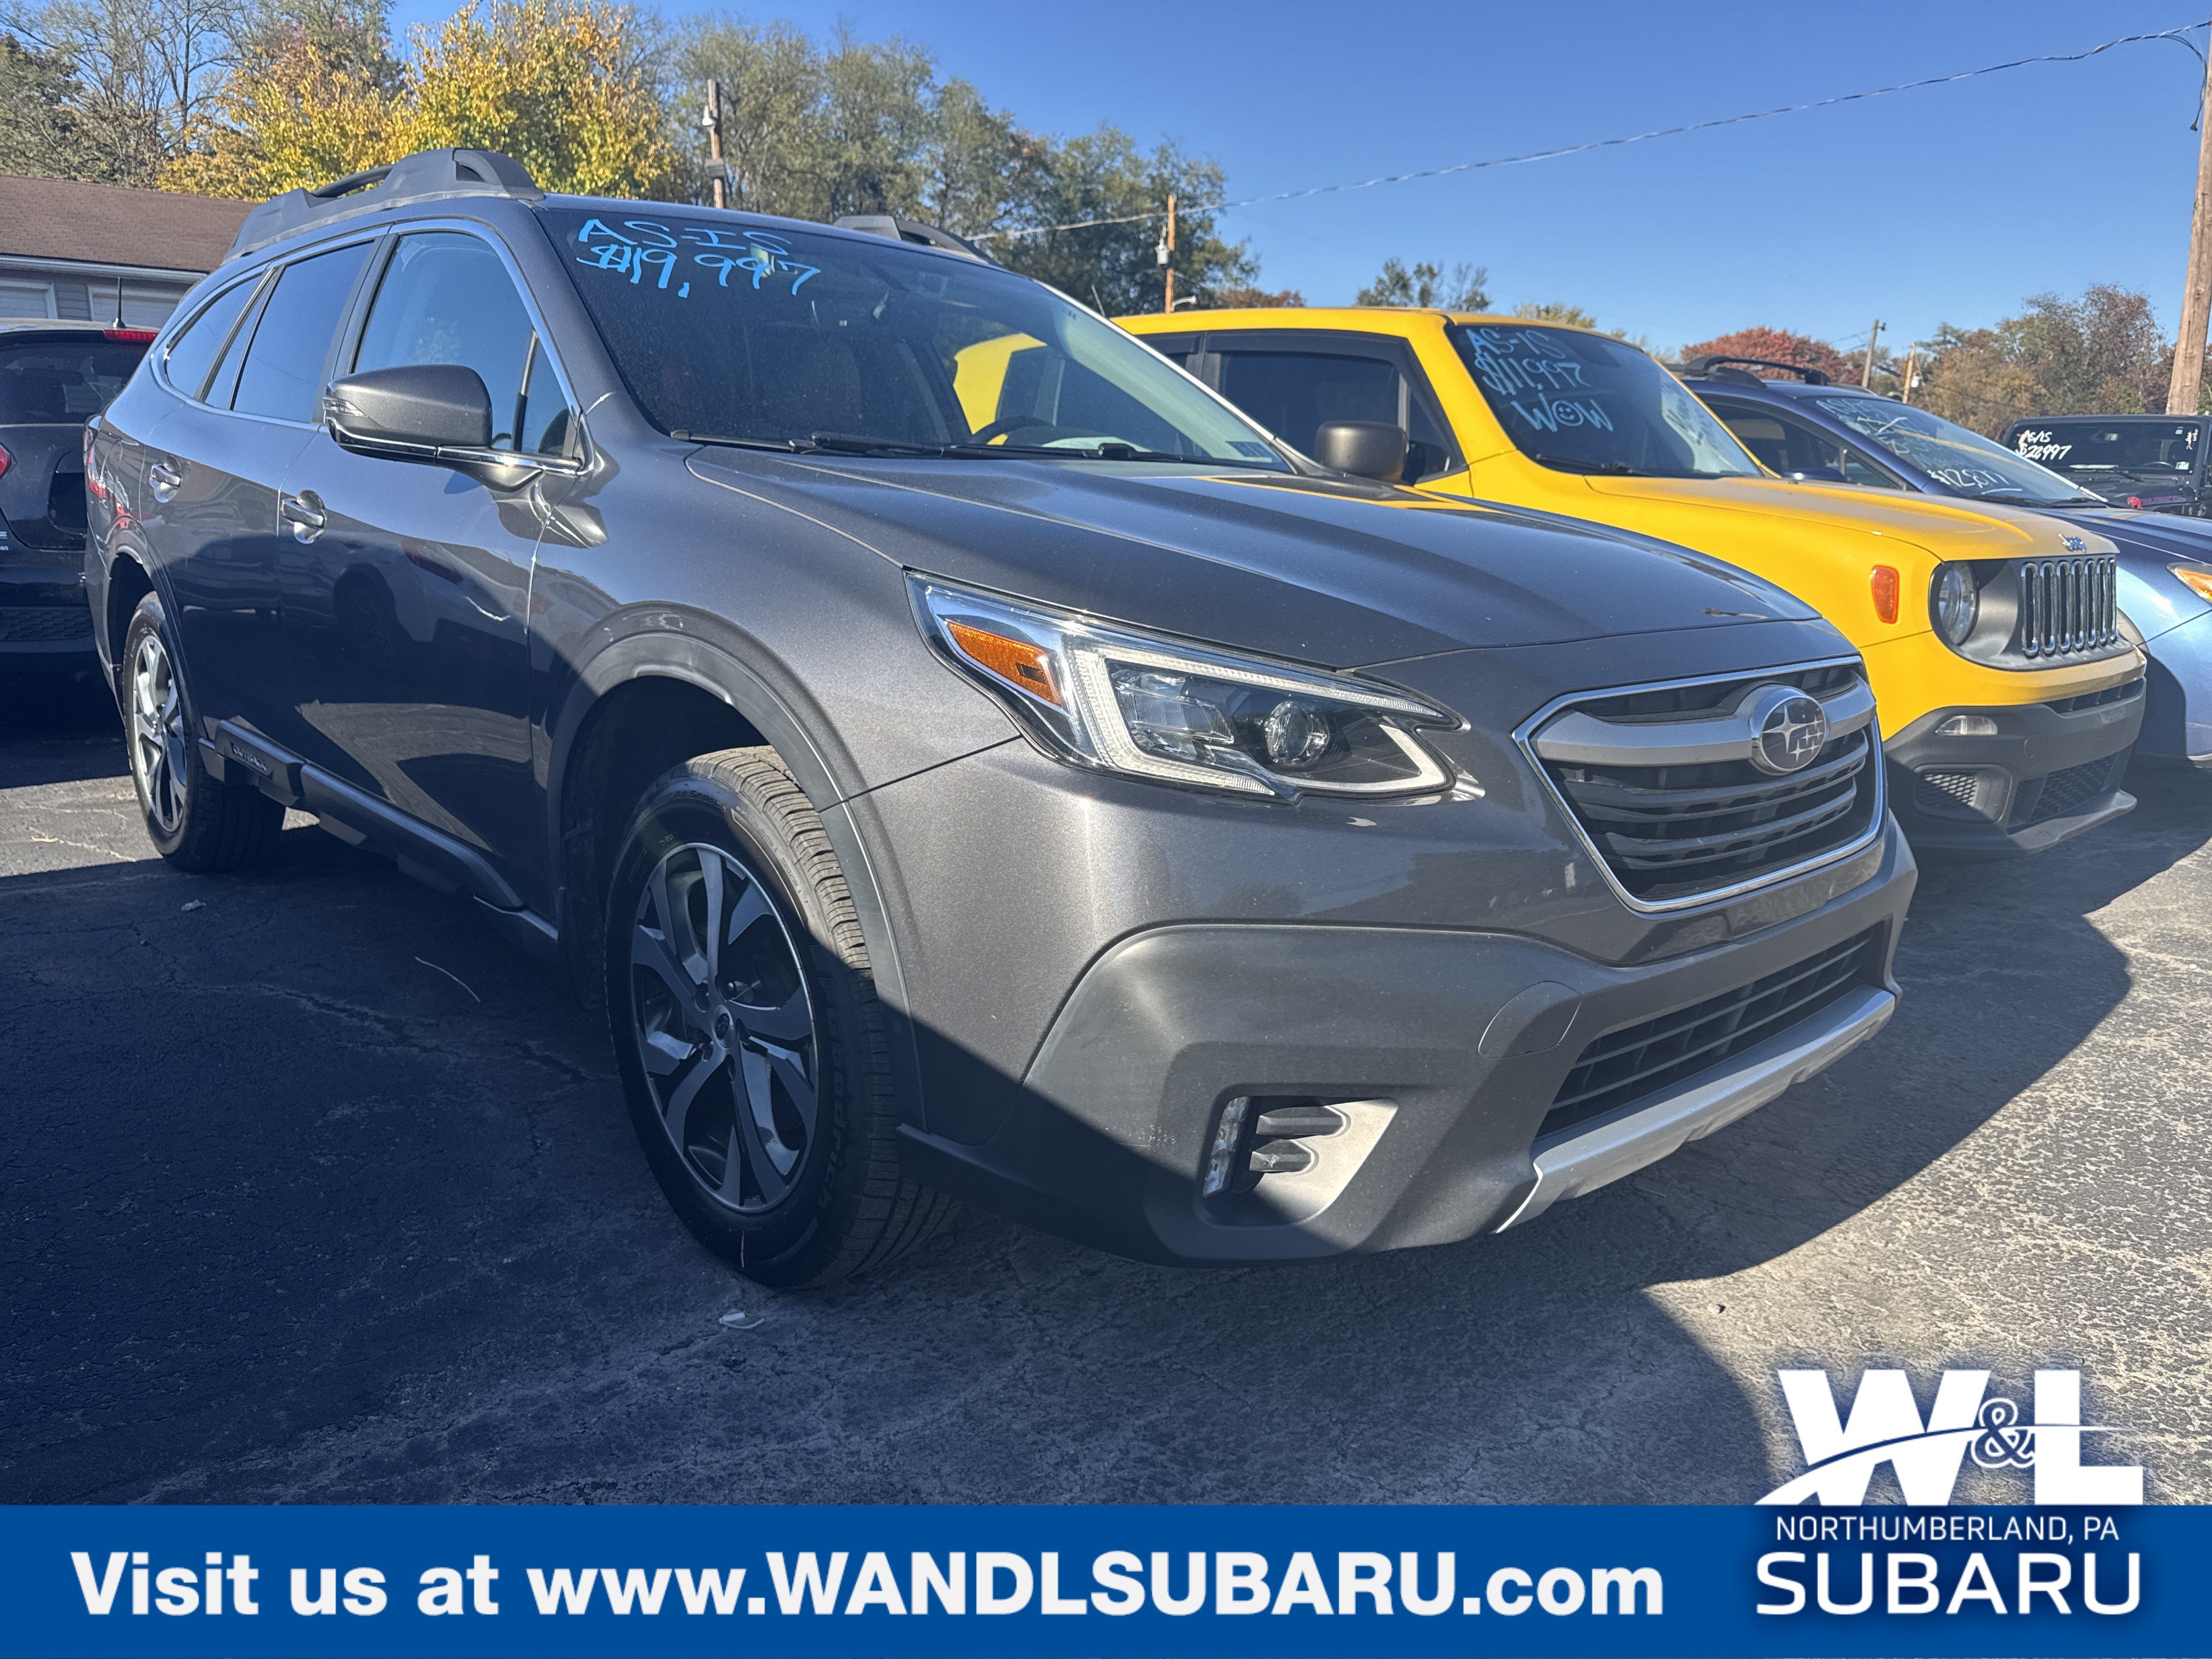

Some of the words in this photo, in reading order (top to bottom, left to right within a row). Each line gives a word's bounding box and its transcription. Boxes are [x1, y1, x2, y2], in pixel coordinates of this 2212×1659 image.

[578, 219, 792, 256] AS-IS
[576, 245, 821, 298] $19,997
[1510, 393, 1613, 432] WOW
